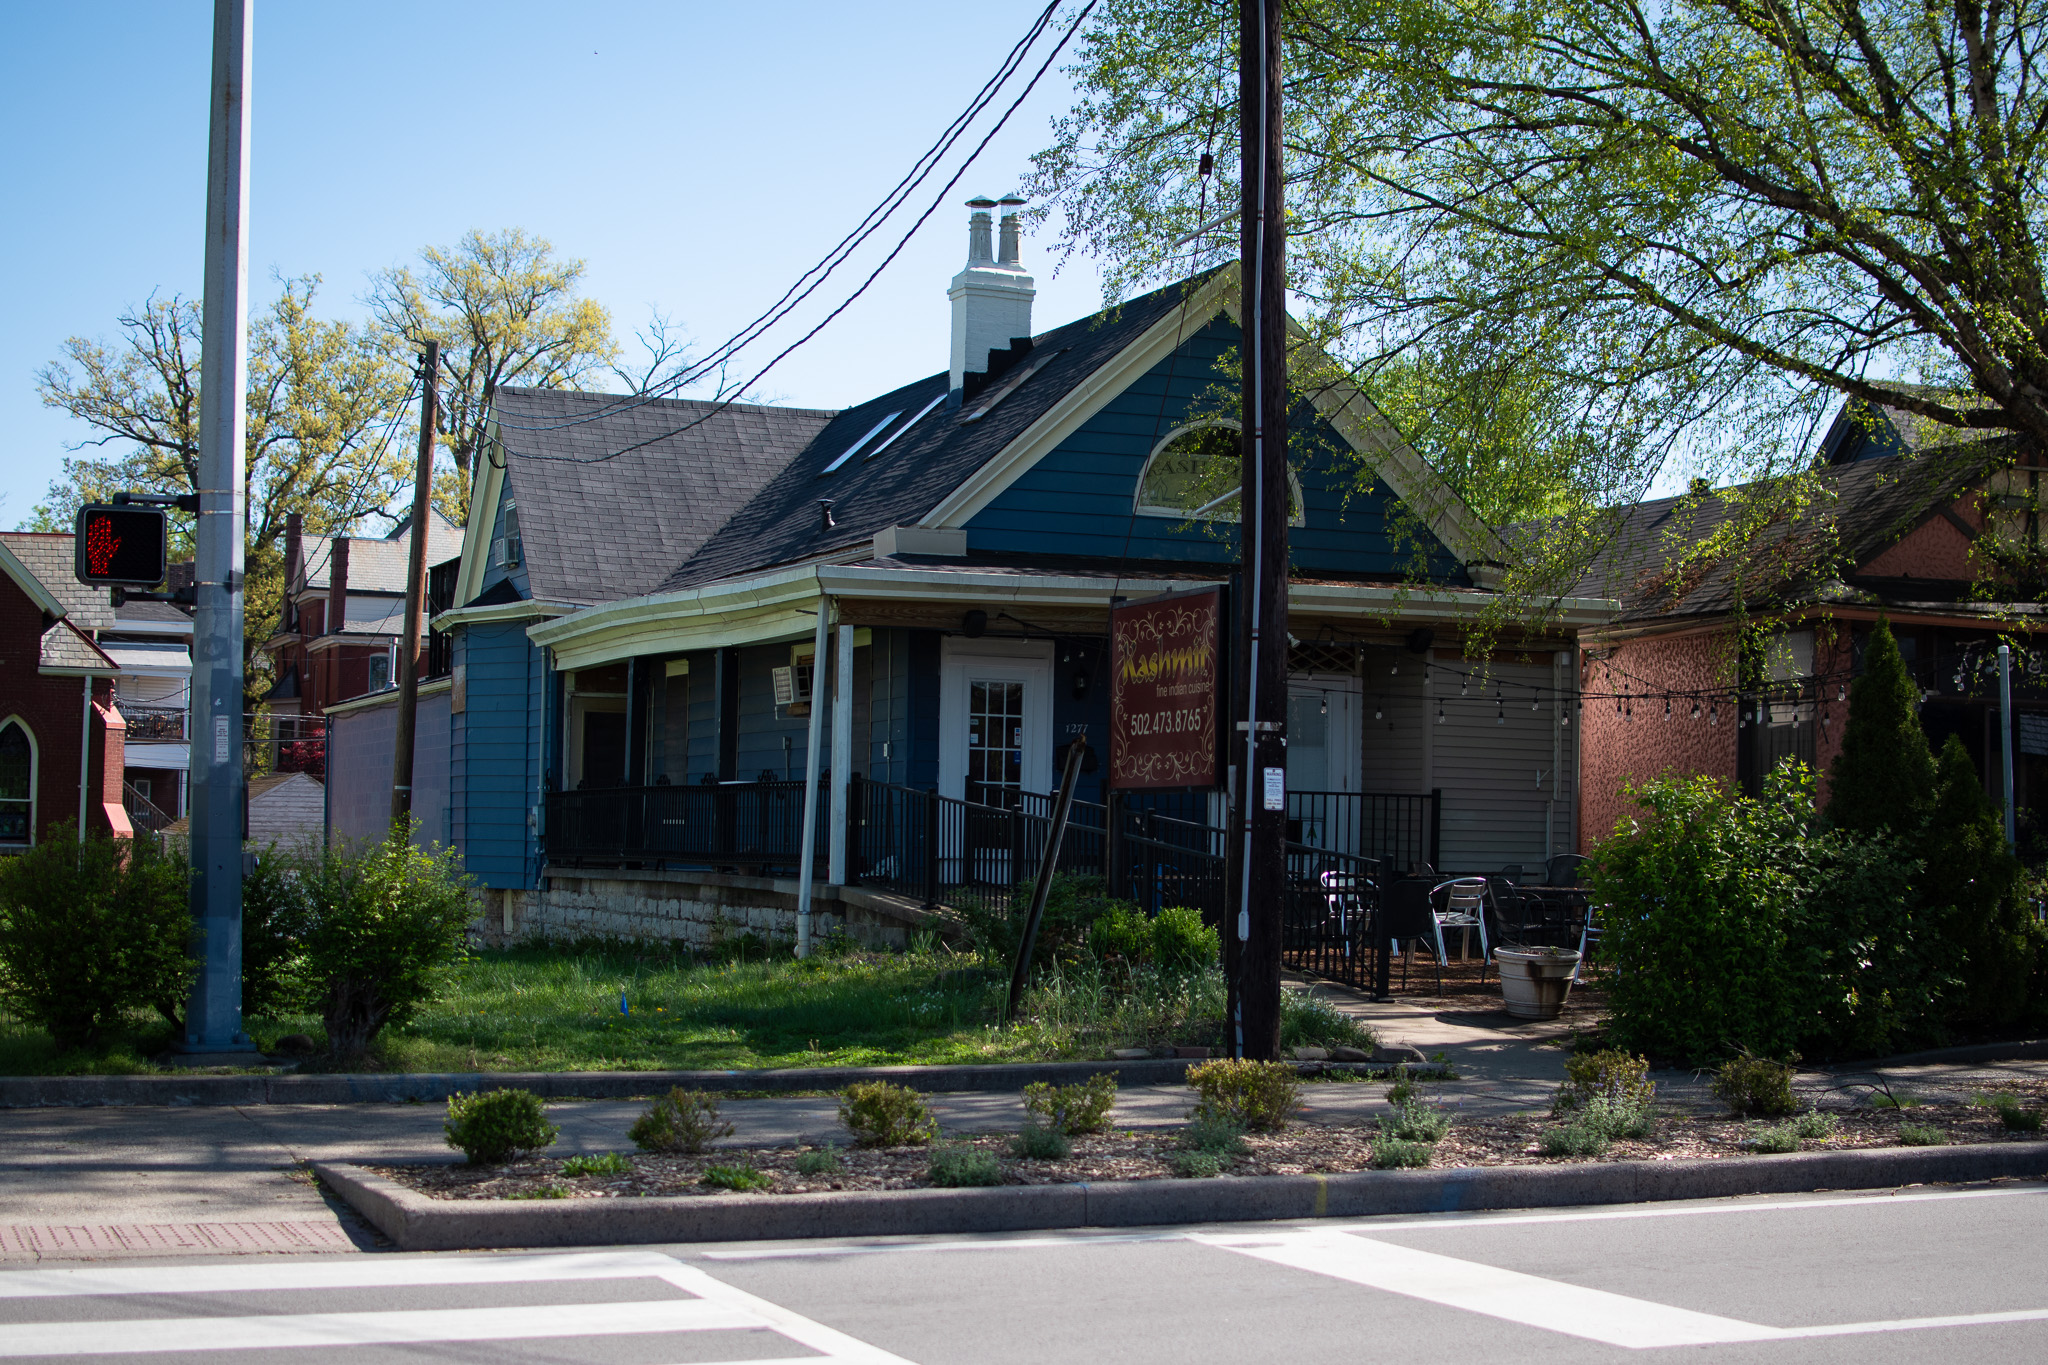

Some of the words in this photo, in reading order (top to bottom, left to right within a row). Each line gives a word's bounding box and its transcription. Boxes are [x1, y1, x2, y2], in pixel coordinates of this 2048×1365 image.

[1123, 636, 1210, 686] Kashmir
[1156, 684, 1168, 697] fine
[1169, 682, 1188, 695] indian
[1188, 680, 1210, 694] cuisine
[1065, 723, 1089, 734] 1277
[1130, 708, 1201, 736] 502.473.8765
